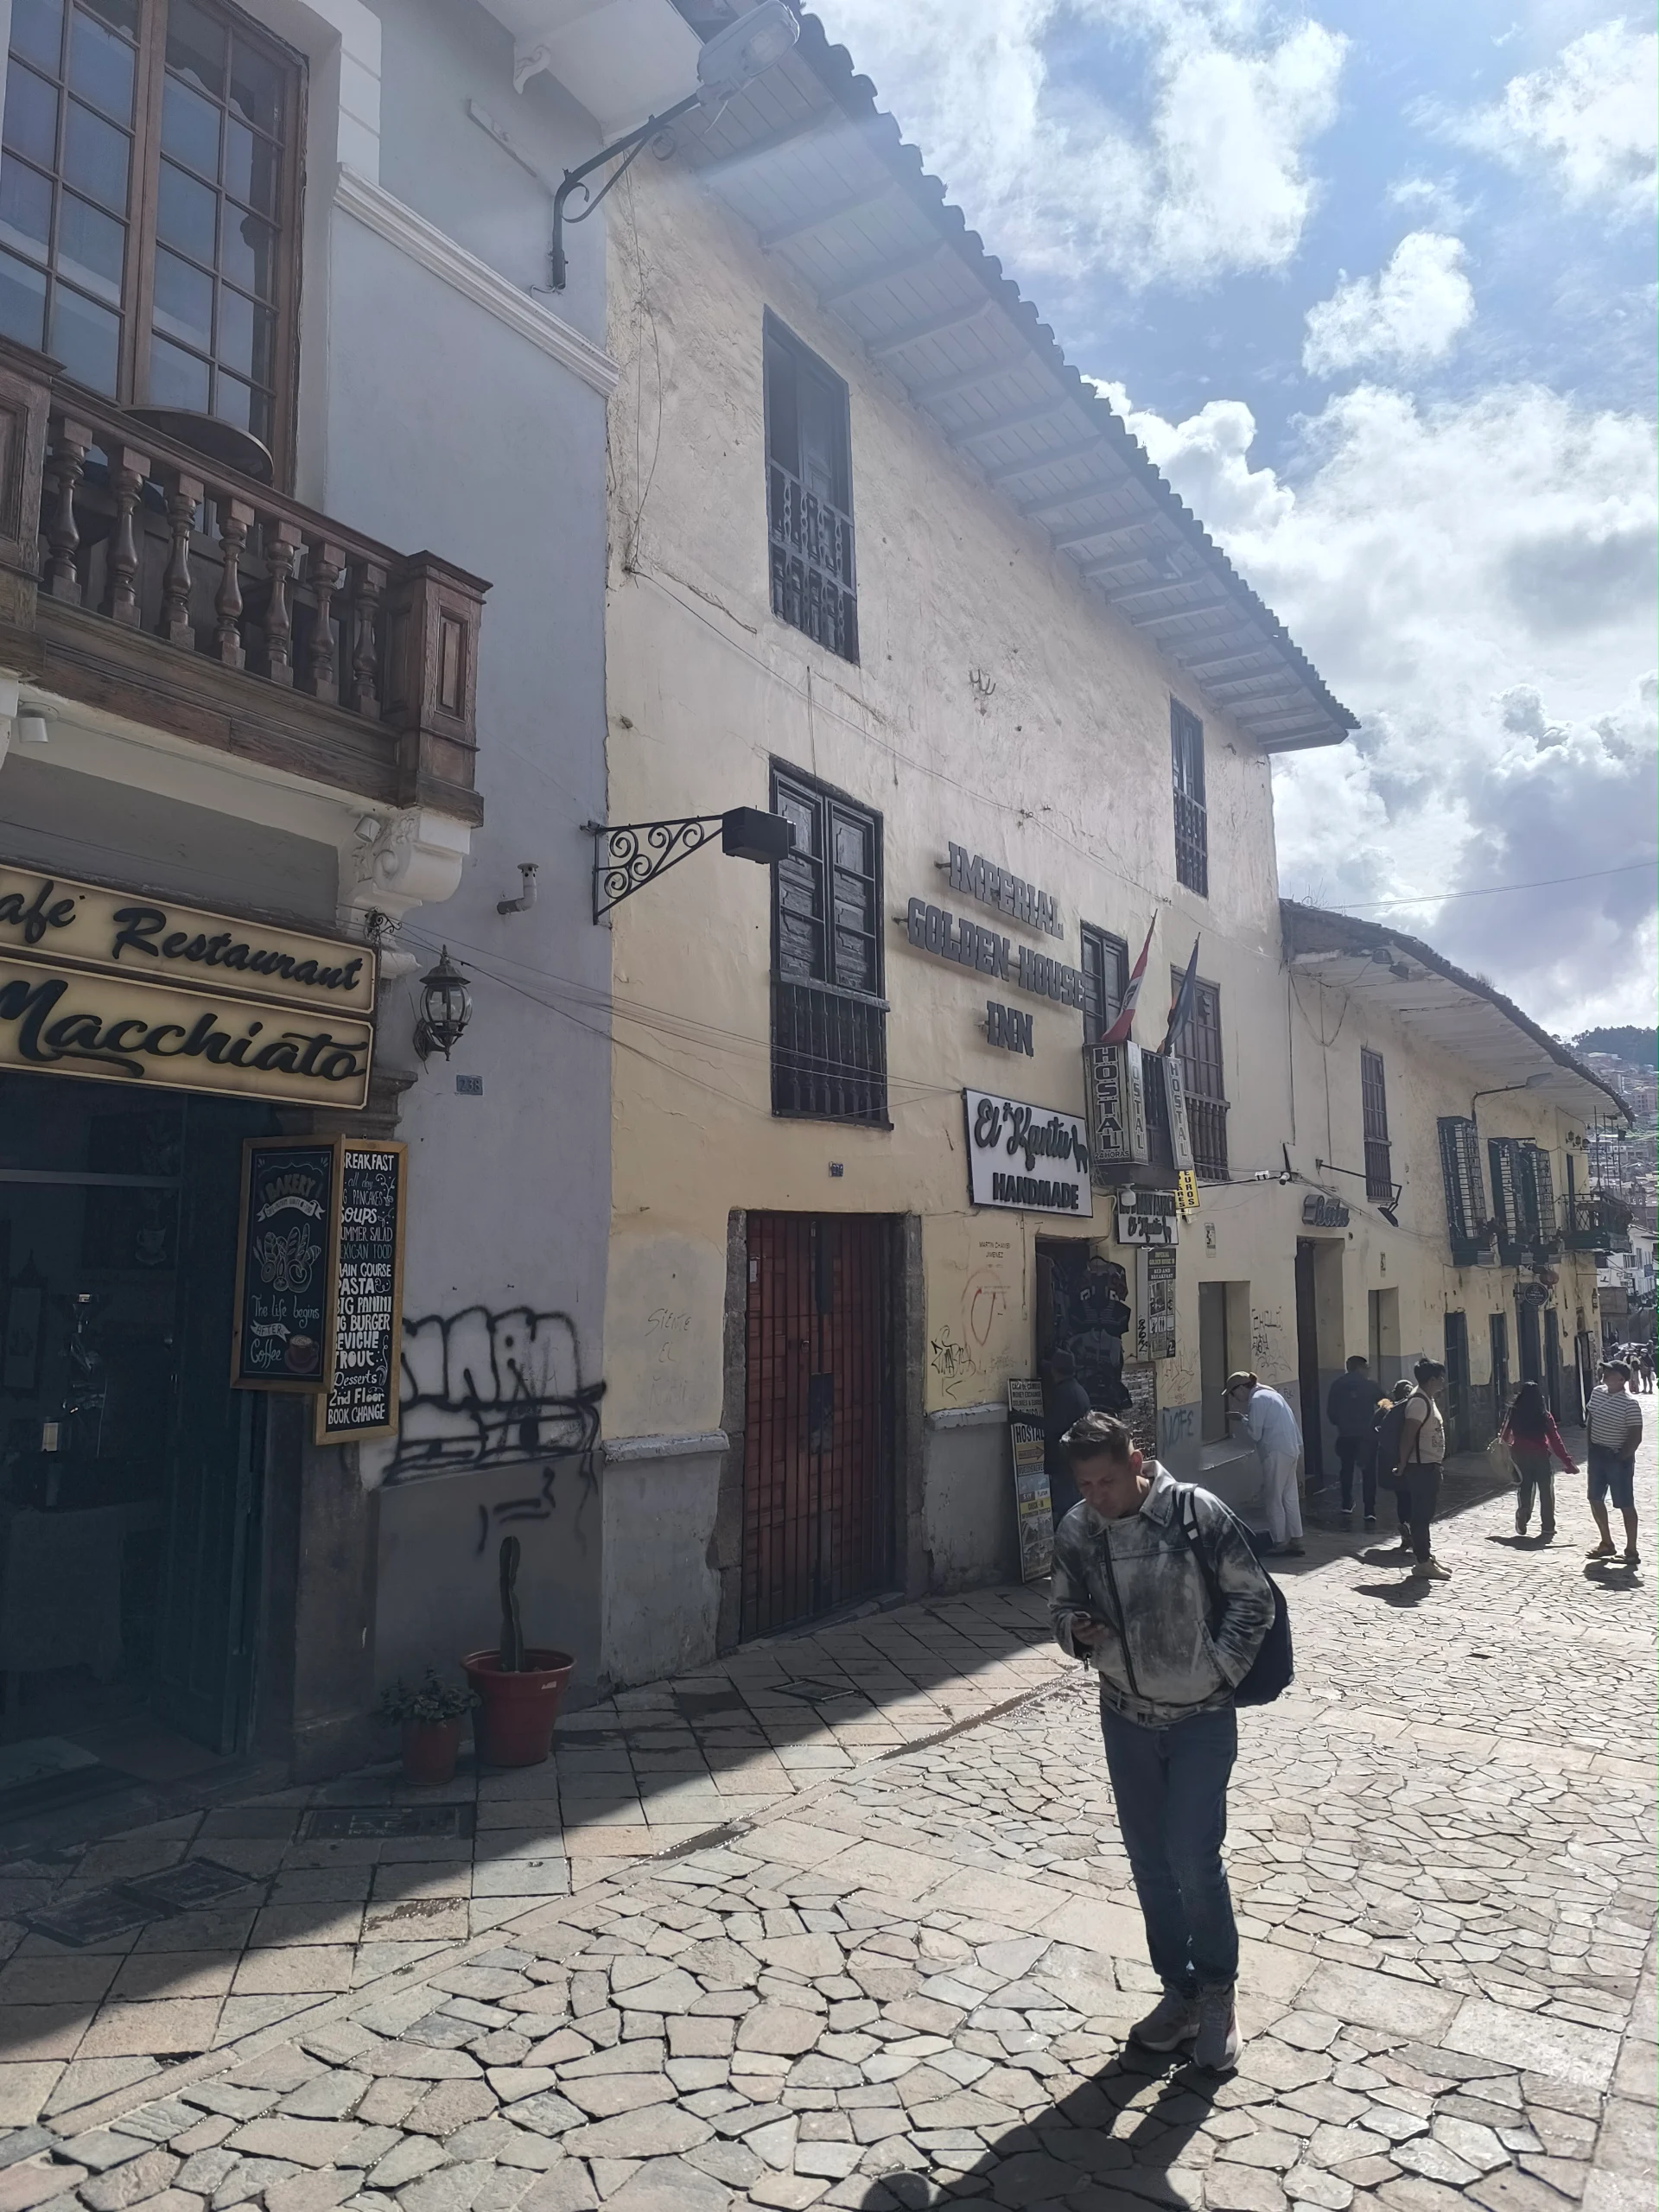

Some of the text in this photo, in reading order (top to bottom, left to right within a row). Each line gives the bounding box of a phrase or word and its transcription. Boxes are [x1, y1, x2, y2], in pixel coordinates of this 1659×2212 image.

[949, 841, 1064, 940] IMPERIAL
[0, 880, 363, 992] afé Restaurant
[907, 897, 1086, 1012] GOLDEN HOUSE
[0, 979, 369, 1082] Macchiato
[987, 1001, 1034, 1058] INN
[459, 1078, 480, 1091] 238
[1093, 1046, 1123, 1150] HOSTAL
[1130, 1046, 1144, 1150] HOSTAL
[1169, 1061, 1188, 1157] HOSTAL
[975, 1097, 1001, 1148] El
[1104, 1150, 1129, 1159] HORAS
[265, 1173, 316, 1202] BAKERY
[353, 1189, 383, 1206] PANCAKES
[993, 1172, 1079, 1210] HANDMADE
[1184, 1170, 1195, 1205] EUROS
[340, 1226, 393, 1242] UMMER SALAD
[340, 1243, 391, 1260] EXICAN FOOD
[360, 1262, 391, 1277] COURSE
[251, 1294, 320, 1329] The life begins
[358, 1295, 391, 1313] PANINI
[256, 1324, 282, 1336] AFTER
[350, 1313, 391, 1332] BURGER
[336, 1331, 379, 1350] EVICHE
[250, 1338, 282, 1369] Coffee
[334, 1370, 378, 1387] Desserts
[329, 1387, 385, 1407] 2nd Floor
[327, 1403, 385, 1425] BOOK CHANGE
[1015, 1425, 1045, 1443] HOSTAL
